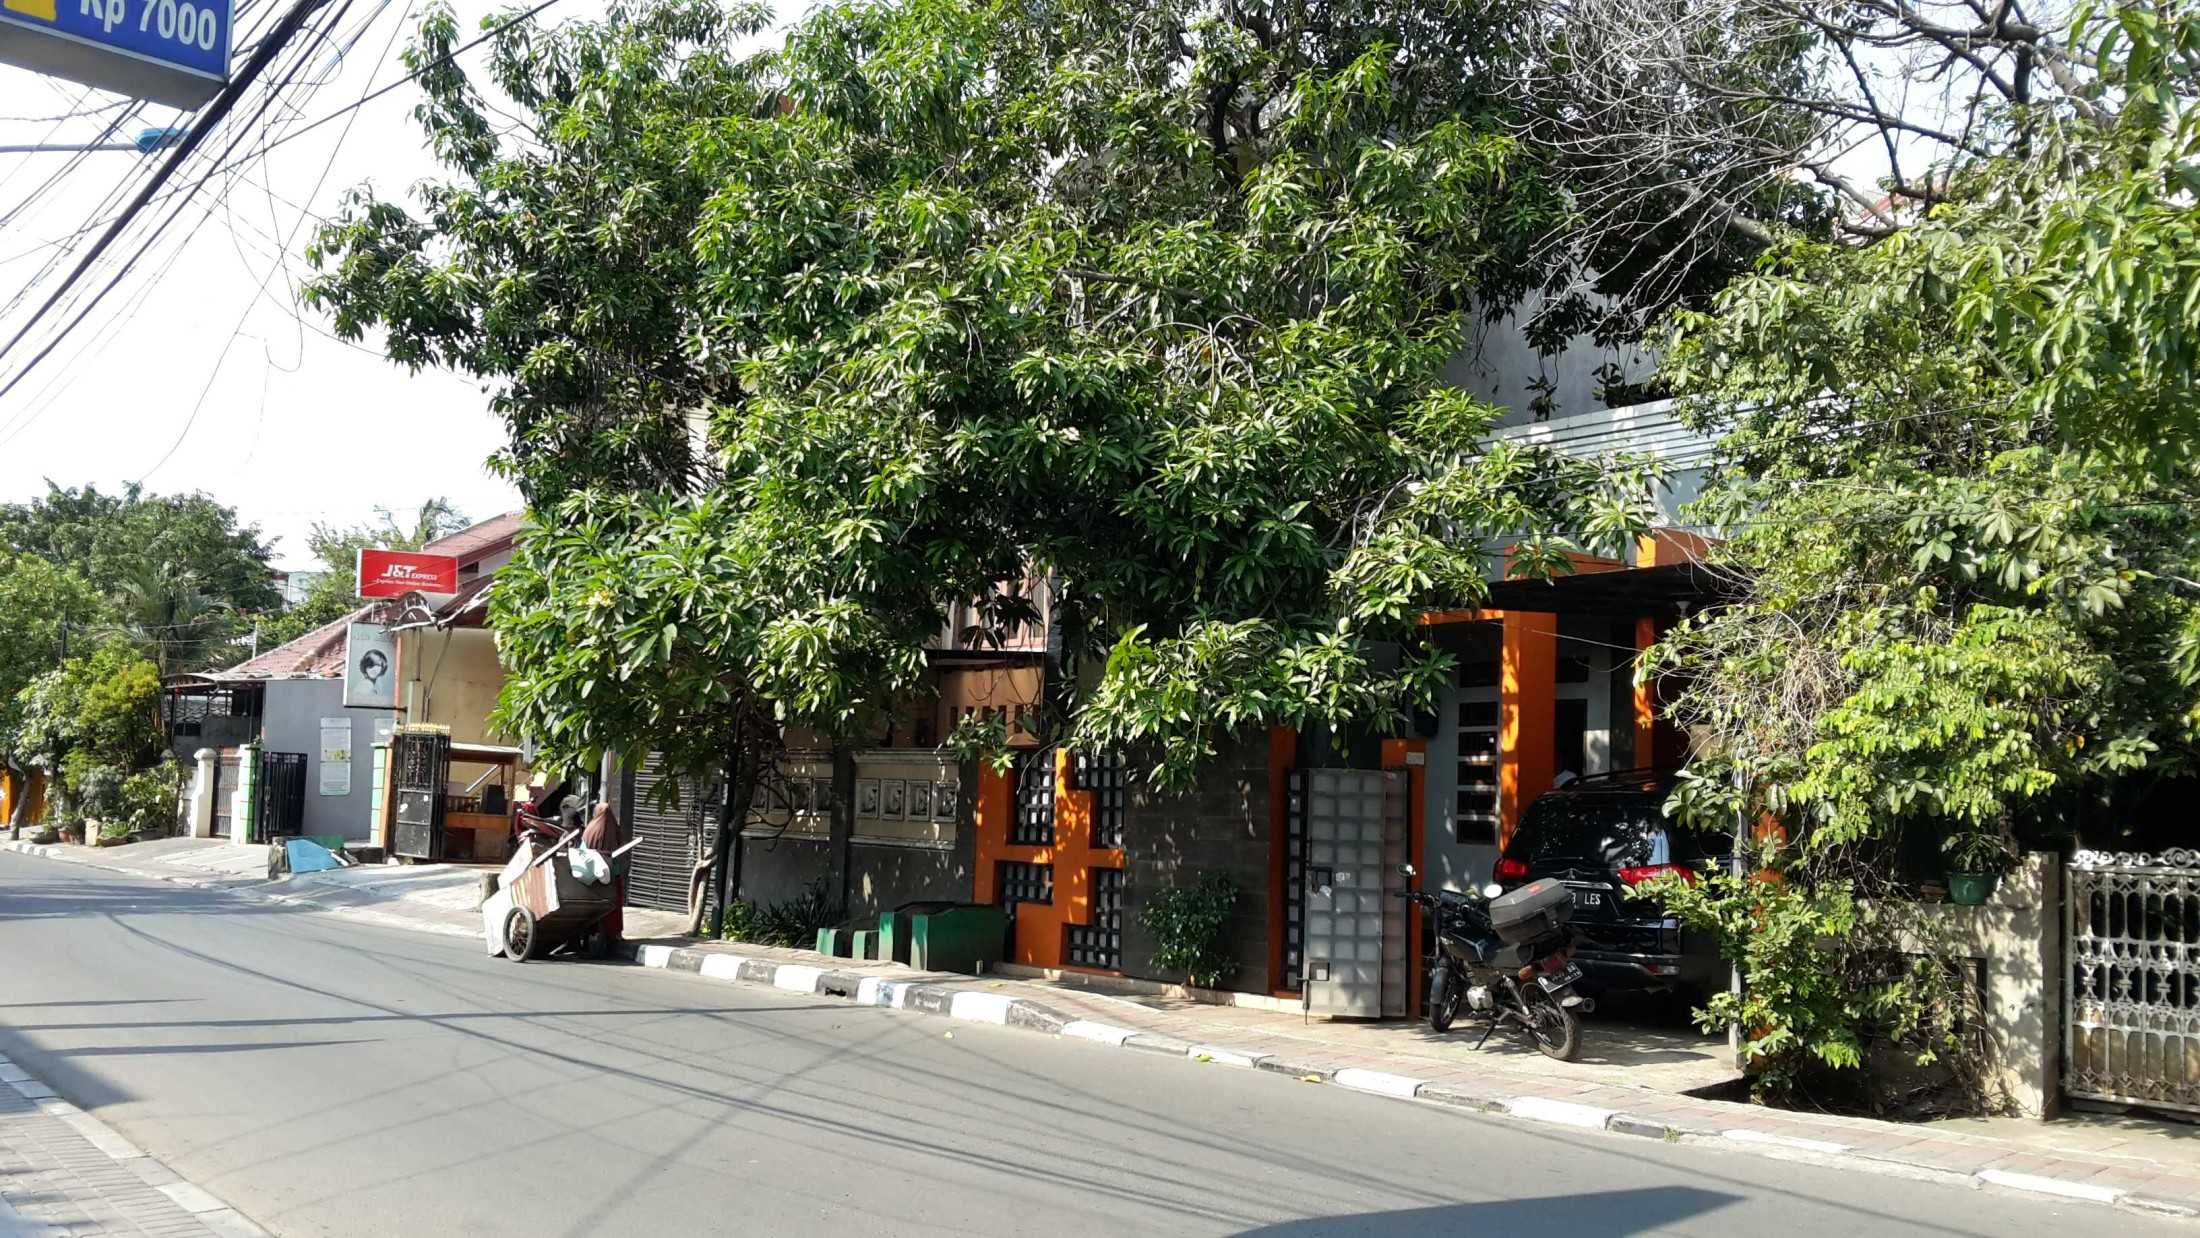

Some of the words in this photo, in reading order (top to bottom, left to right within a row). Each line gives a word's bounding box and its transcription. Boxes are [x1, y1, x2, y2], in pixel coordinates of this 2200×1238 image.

[139, 0, 217, 51] 7000
[381, 564, 418, 578] J&T
[1584, 892, 1601, 905] LES
